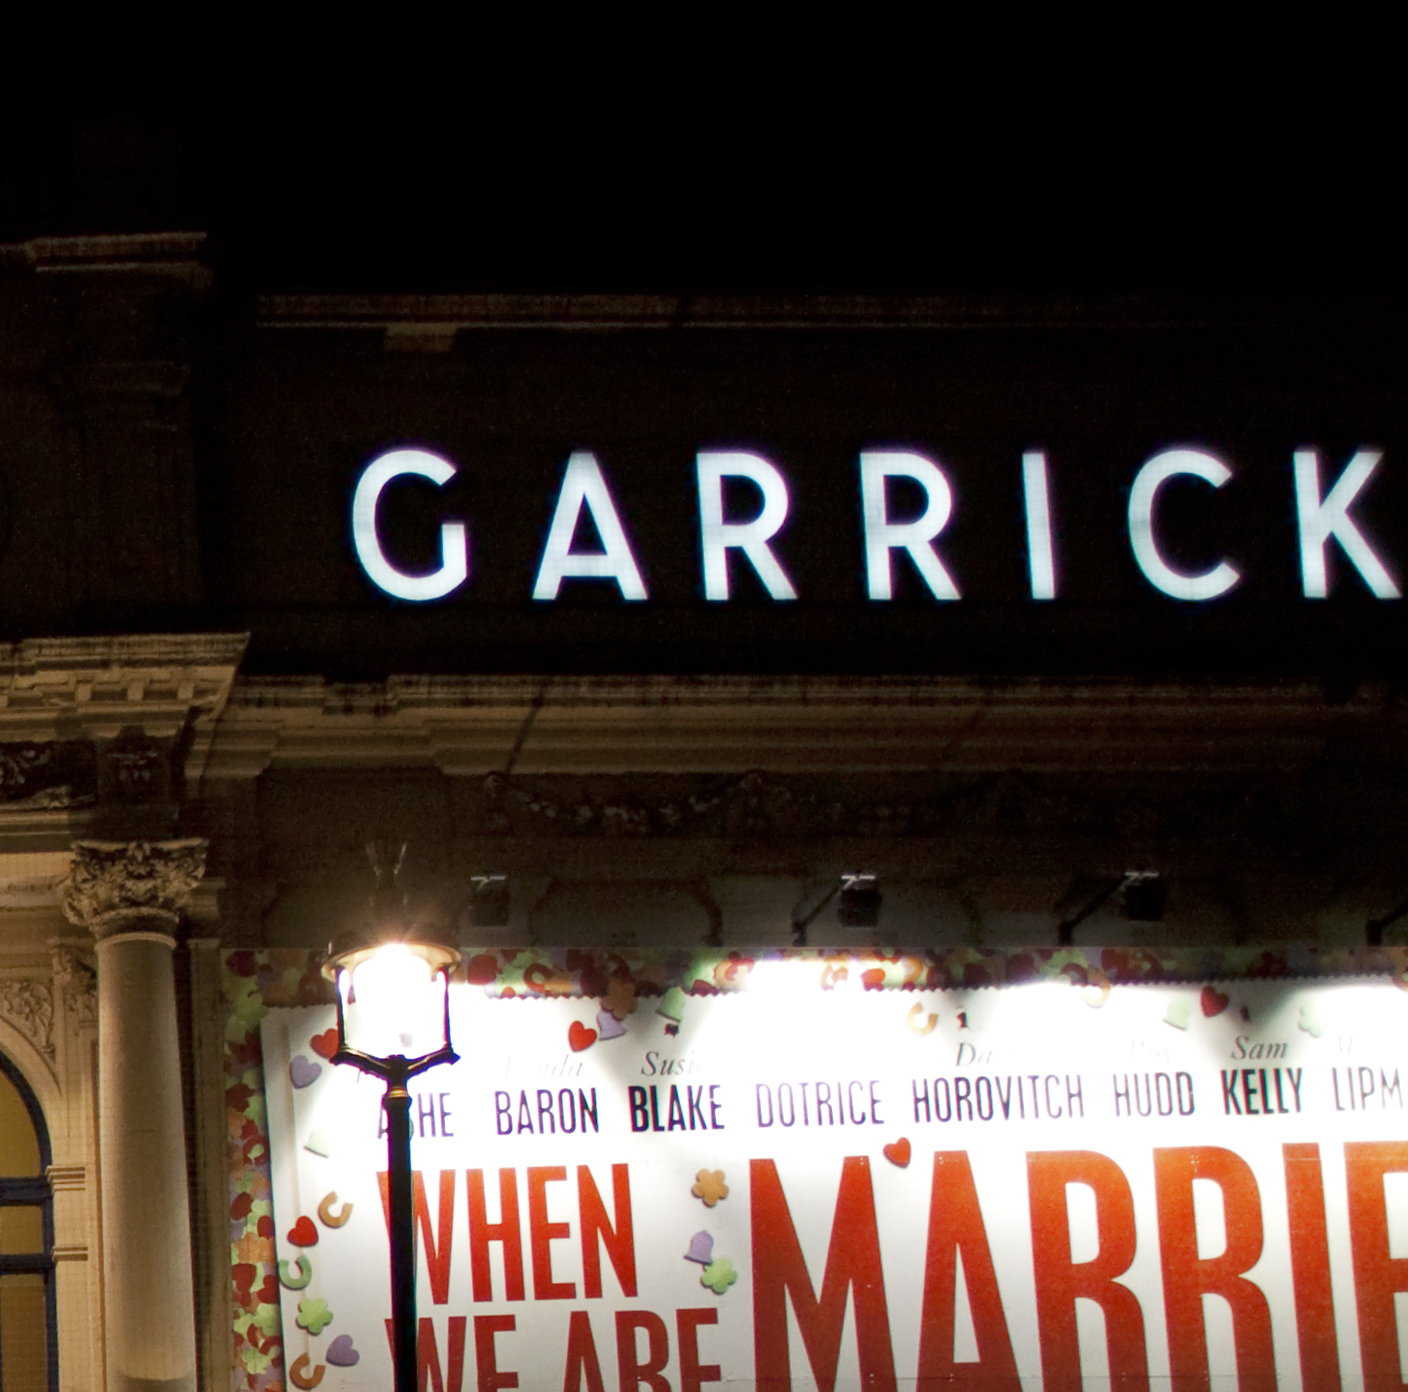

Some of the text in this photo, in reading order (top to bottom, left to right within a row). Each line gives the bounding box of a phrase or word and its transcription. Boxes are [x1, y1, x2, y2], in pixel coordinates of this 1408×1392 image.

[351, 446, 1403, 602] GARRICK
[494, 1086, 600, 1136] BARON
[627, 1084, 726, 1133] BLAKE
[754, 1079, 886, 1129] DOTRICE
[911, 1074, 1086, 1124] HOROVITCH
[1113, 1071, 1196, 1119] HUDD
[1219, 1066, 1305, 1116] KELLY
[1230, 1034, 1289, 1062] Sam
[376, 1162, 639, 1306] WHEN
